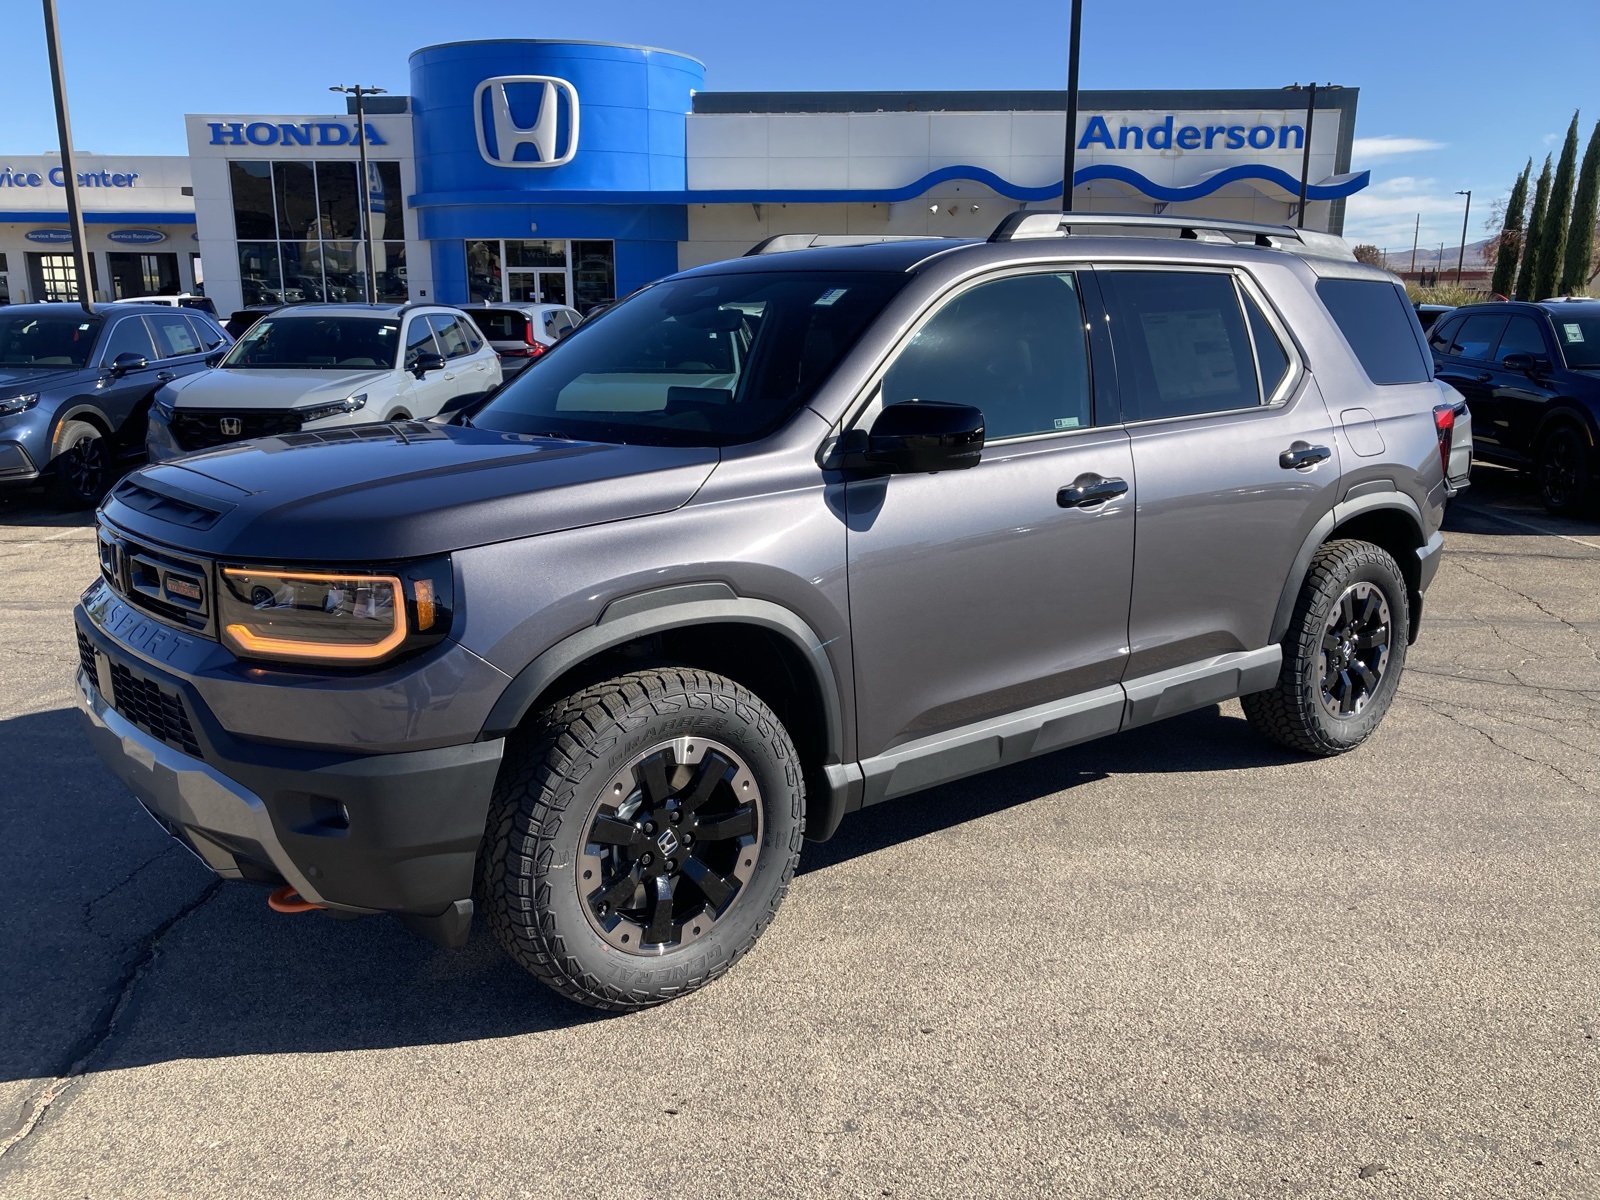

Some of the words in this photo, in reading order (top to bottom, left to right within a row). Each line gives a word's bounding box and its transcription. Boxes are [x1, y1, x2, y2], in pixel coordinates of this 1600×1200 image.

[207, 122, 387, 146] HONDA
[1077, 115, 1304, 150] Anderson
[606, 943, 723, 985] GENERAL
